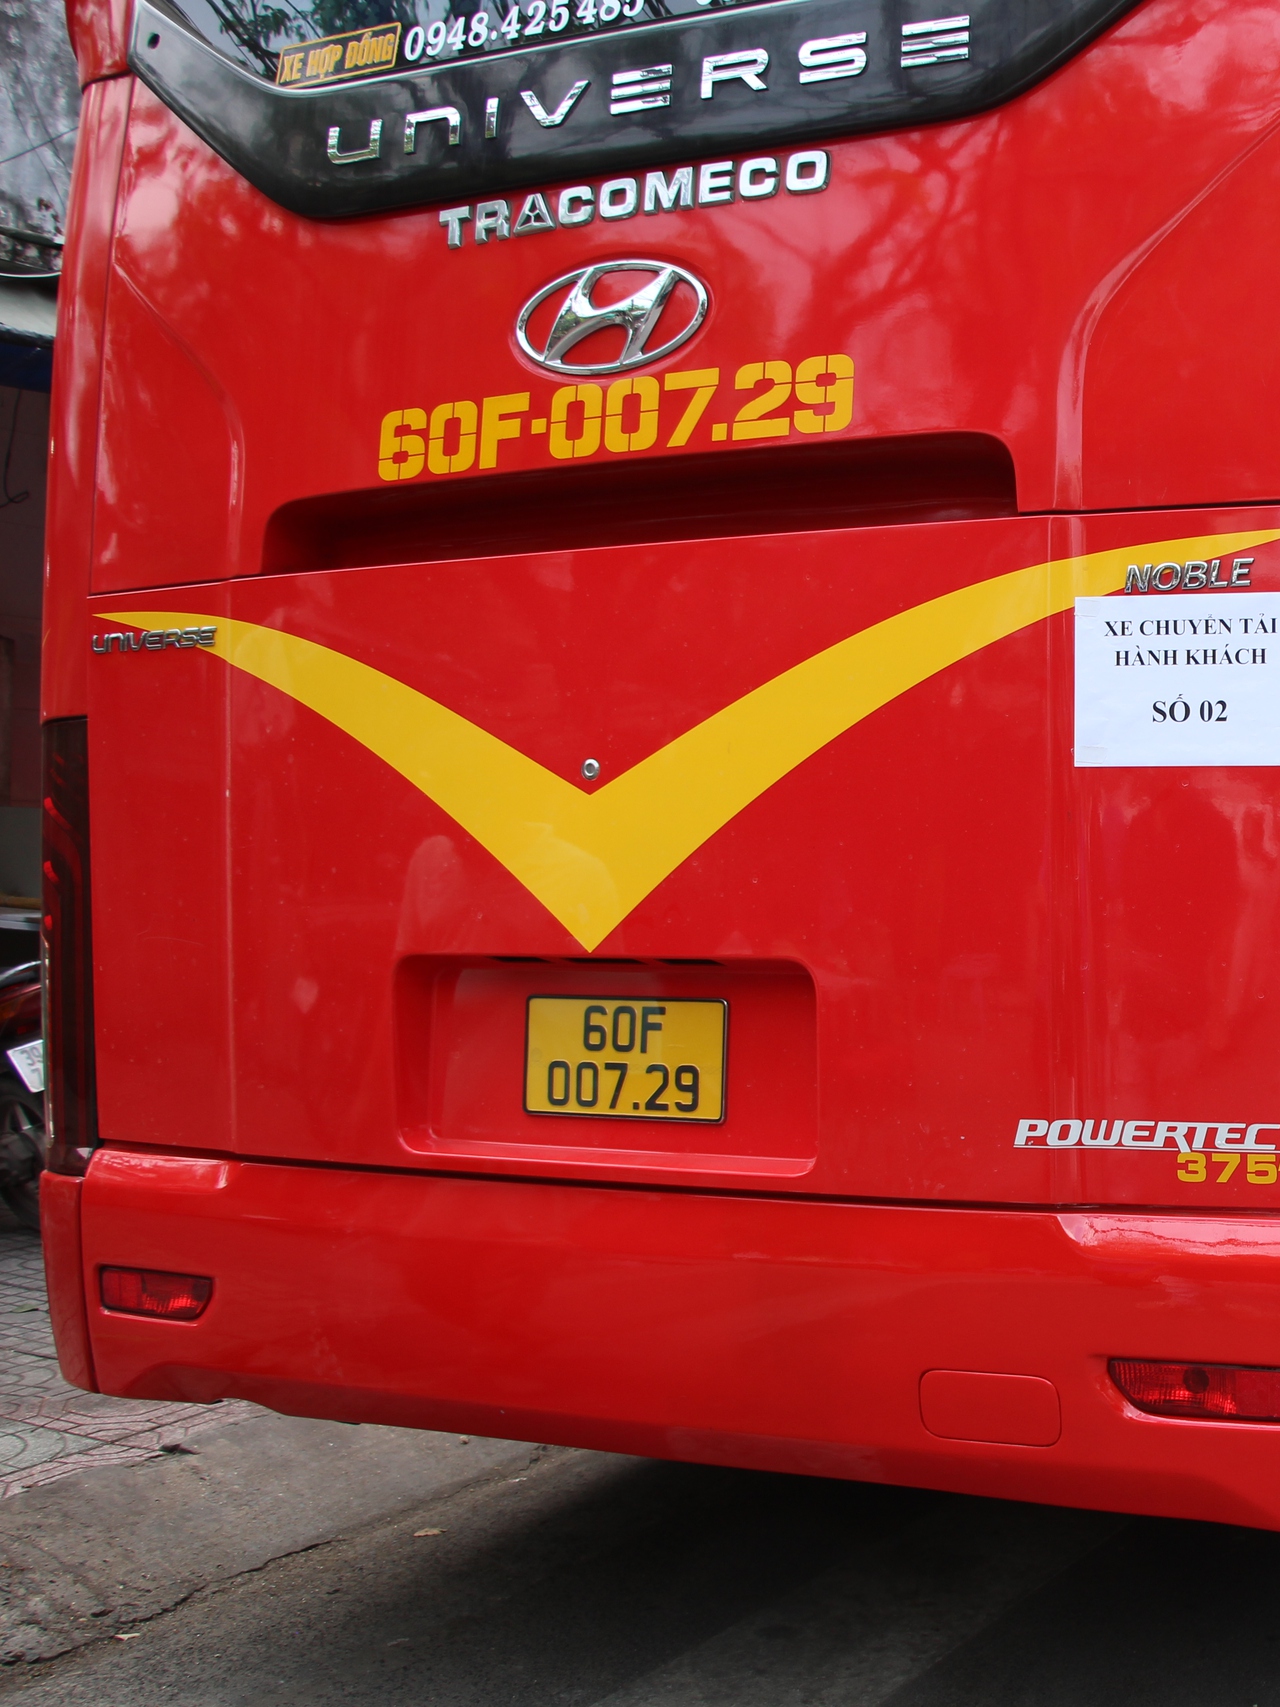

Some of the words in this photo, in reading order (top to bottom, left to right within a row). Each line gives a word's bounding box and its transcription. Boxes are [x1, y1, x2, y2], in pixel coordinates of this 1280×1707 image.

[280, 52, 305, 83] XE
[306, 44, 343, 80] HỢP
[438, 150, 832, 250] TRACOMECO
[378, 353, 856, 482] 60F-007.29
[1124, 557, 1255, 593] NOBLE
[92, 625, 218, 654] UNIVERSE
[1104, 620, 1133, 637] XE
[1139, 613, 1233, 636] CHUYỂN
[1239, 612, 1278, 635] TẢI
[1114, 645, 1178, 667] HÀNH
[1184, 643, 1268, 666] KHÁCH
[1152, 693, 1191, 723] SỐ
[1199, 700, 1229, 723] 02
[583, 1004, 667, 1055] 60F
[547, 1060, 700, 1112] 007.29
